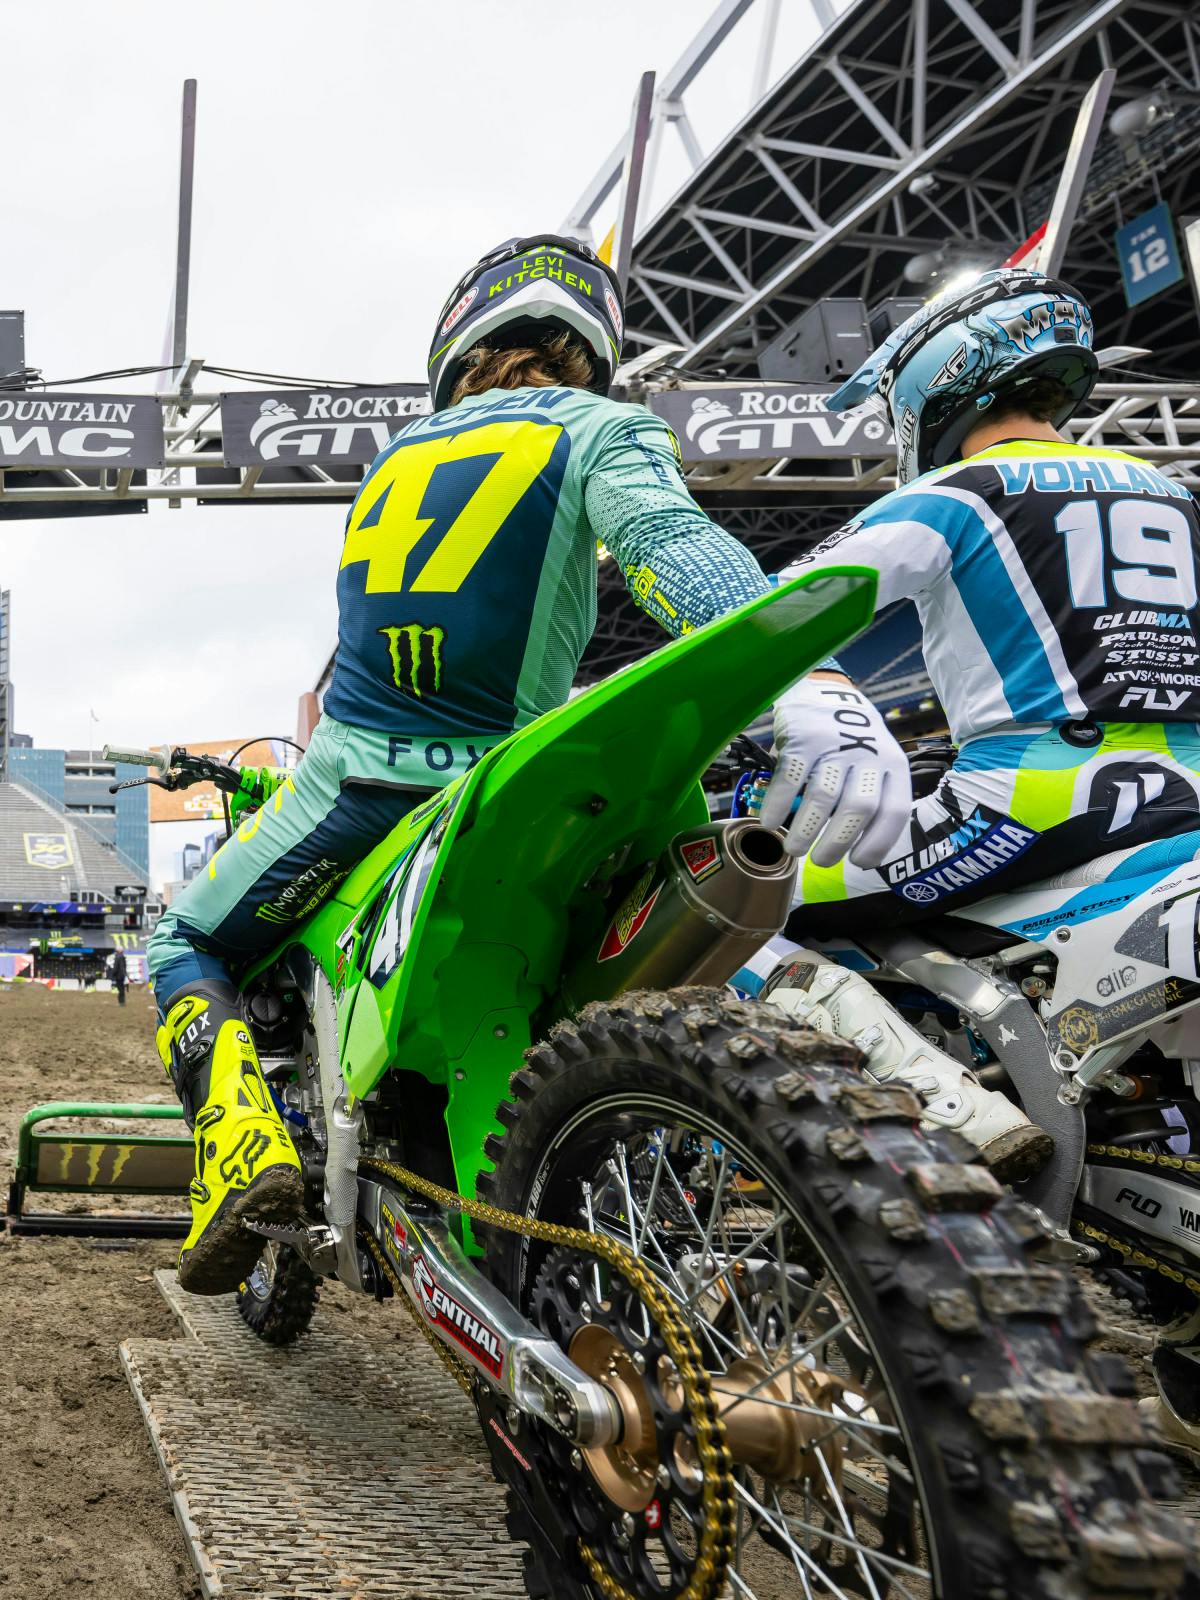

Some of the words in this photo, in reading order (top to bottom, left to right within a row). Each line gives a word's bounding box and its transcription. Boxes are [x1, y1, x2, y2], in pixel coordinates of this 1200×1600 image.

[522, 255, 564, 269] LEVI
[1128, 238, 1170, 283] 12
[488, 267, 593, 298] KITCHEN
[444, 294, 473, 330] BELL
[738, 391, 832, 416] ROCK
[339, 420, 565, 595] 47
[1054, 498, 1198, 611] 19
[1099, 631, 1197, 648] PAULSON
[1104, 649, 1200, 666] STUSSY
[1118, 686, 1193, 711] FLY
[820, 690, 879, 757] FOX
[926, 822, 1036, 892] YAMAHA
[1022, 908, 1077, 932] PAULSON
[1080, 892, 1137, 915] STUSSY
[1157, 896, 1200, 979] 1
[179, 1011, 211, 1055] FOX
[273, 1124, 291, 1149] FOX
[1115, 1187, 1163, 1219] FLO
